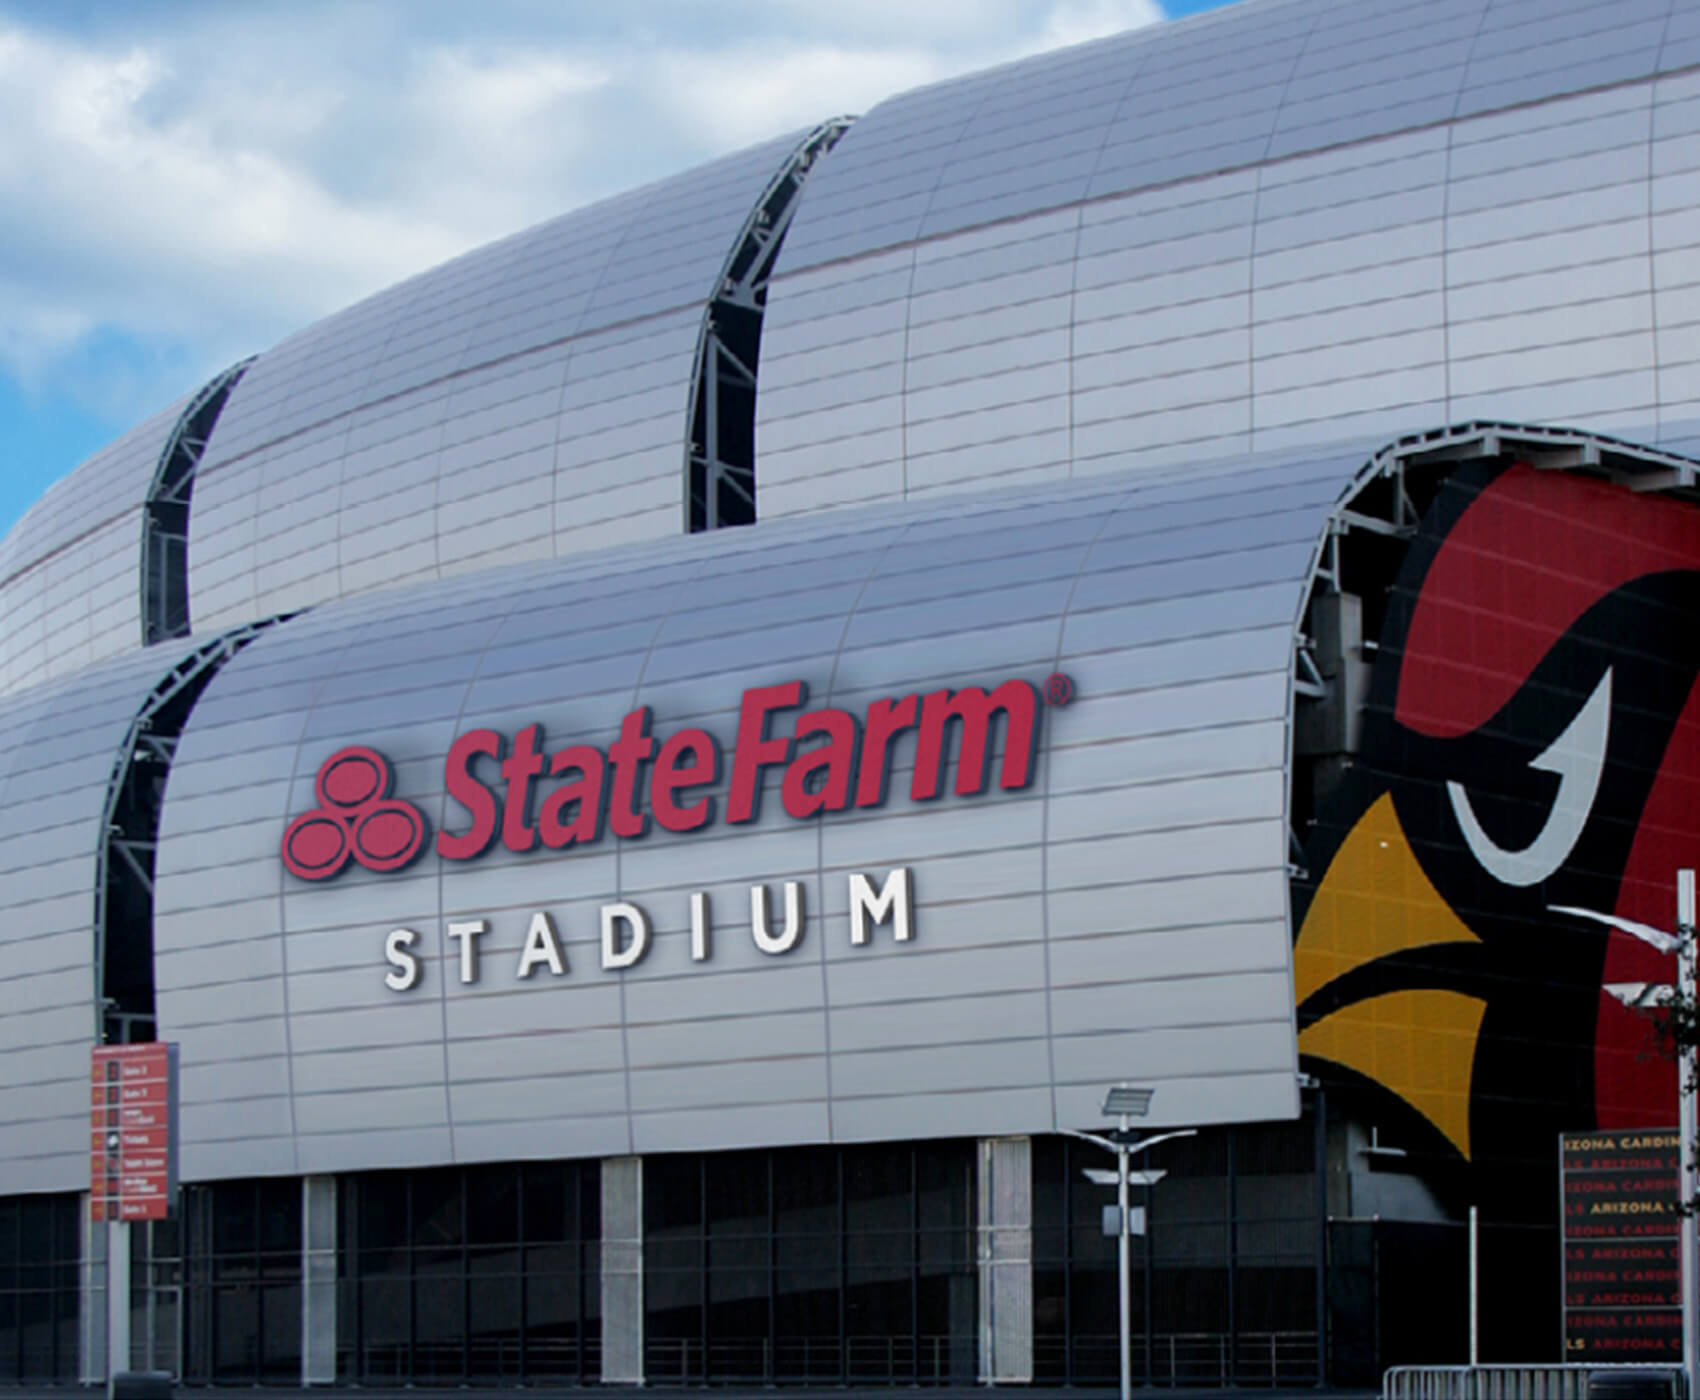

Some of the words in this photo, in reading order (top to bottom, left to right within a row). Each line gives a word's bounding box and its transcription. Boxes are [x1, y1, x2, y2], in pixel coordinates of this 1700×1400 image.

[385, 867, 914, 991] STADIUM
[1590, 1200, 1665, 1216] ARIZONA
[1592, 1247, 1665, 1259] ARIZONA
[1592, 1291, 1665, 1304] ARIZONA
[1567, 1337, 1585, 1350] LS
[1592, 1336, 1665, 1350] ARIZONA
